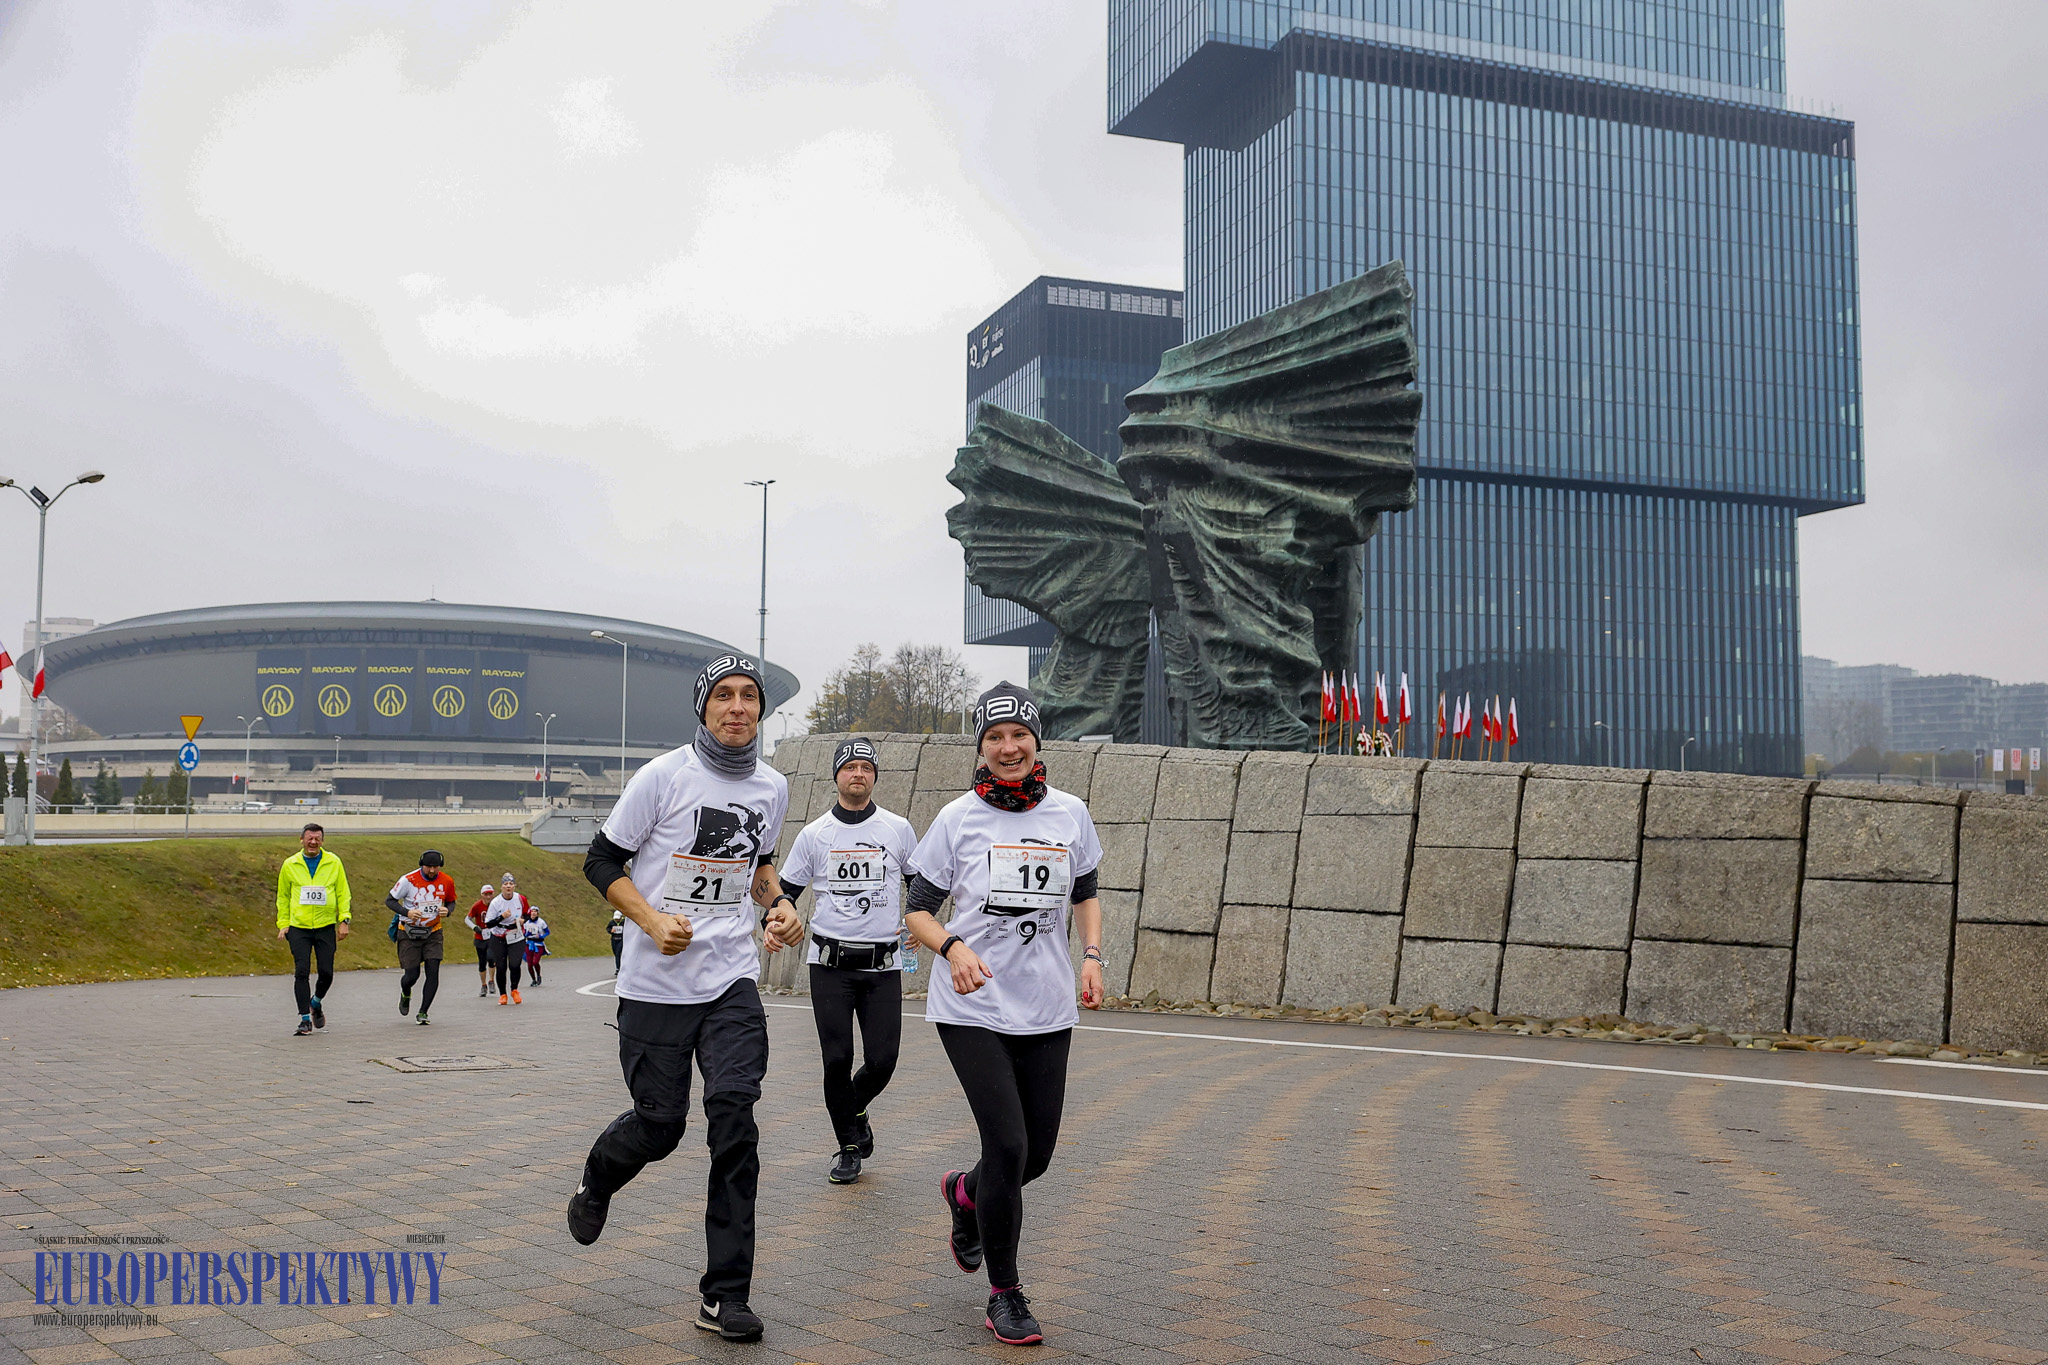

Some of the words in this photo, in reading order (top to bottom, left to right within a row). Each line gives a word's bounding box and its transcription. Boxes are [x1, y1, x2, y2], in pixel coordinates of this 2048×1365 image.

[257, 667, 303, 675] MAYDAY
[426, 667, 472, 675] MAYDAY
[481, 669, 526, 678] MAYDAY
[838, 862, 870, 879] 601
[1018, 865, 1050, 890] 19
[690, 876, 723, 900] 21
[306, 892, 322, 900] 103
[424, 905, 438, 913] 452
[857, 897, 870, 914] 9
[1019, 920, 1037, 945] 9
